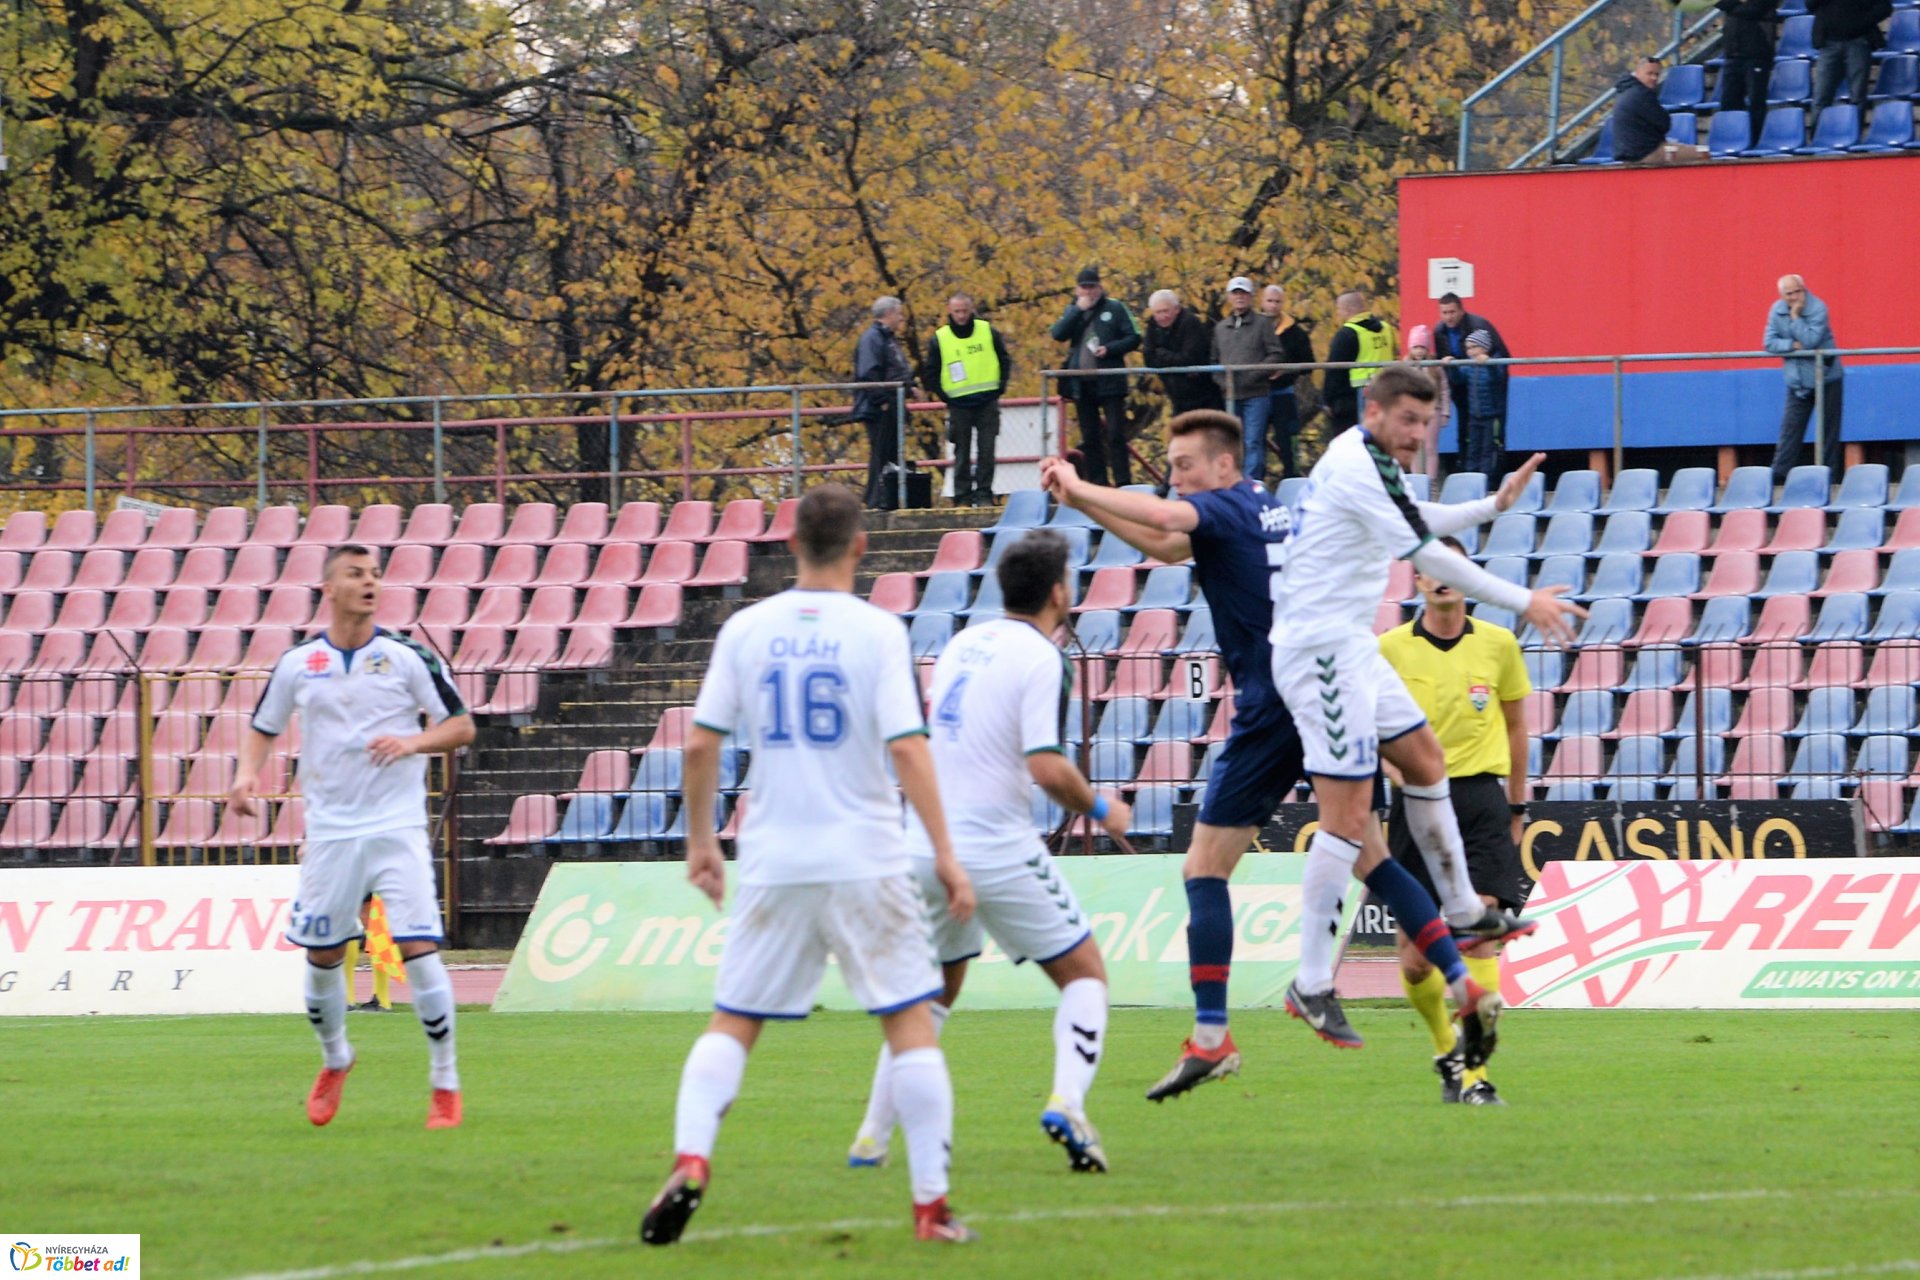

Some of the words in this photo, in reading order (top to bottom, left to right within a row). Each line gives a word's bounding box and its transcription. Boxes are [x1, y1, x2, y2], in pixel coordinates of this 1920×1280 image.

[769, 632, 842, 662] OLÁH
[1191, 662, 1203, 699] B
[760, 662, 850, 750] 16
[935, 669, 972, 742] 4
[1520, 817, 1808, 882] CASINO
[301, 914, 331, 938] 70
[1753, 970, 1865, 989] ALWAYS
[1862, 970, 1907, 989] ON
